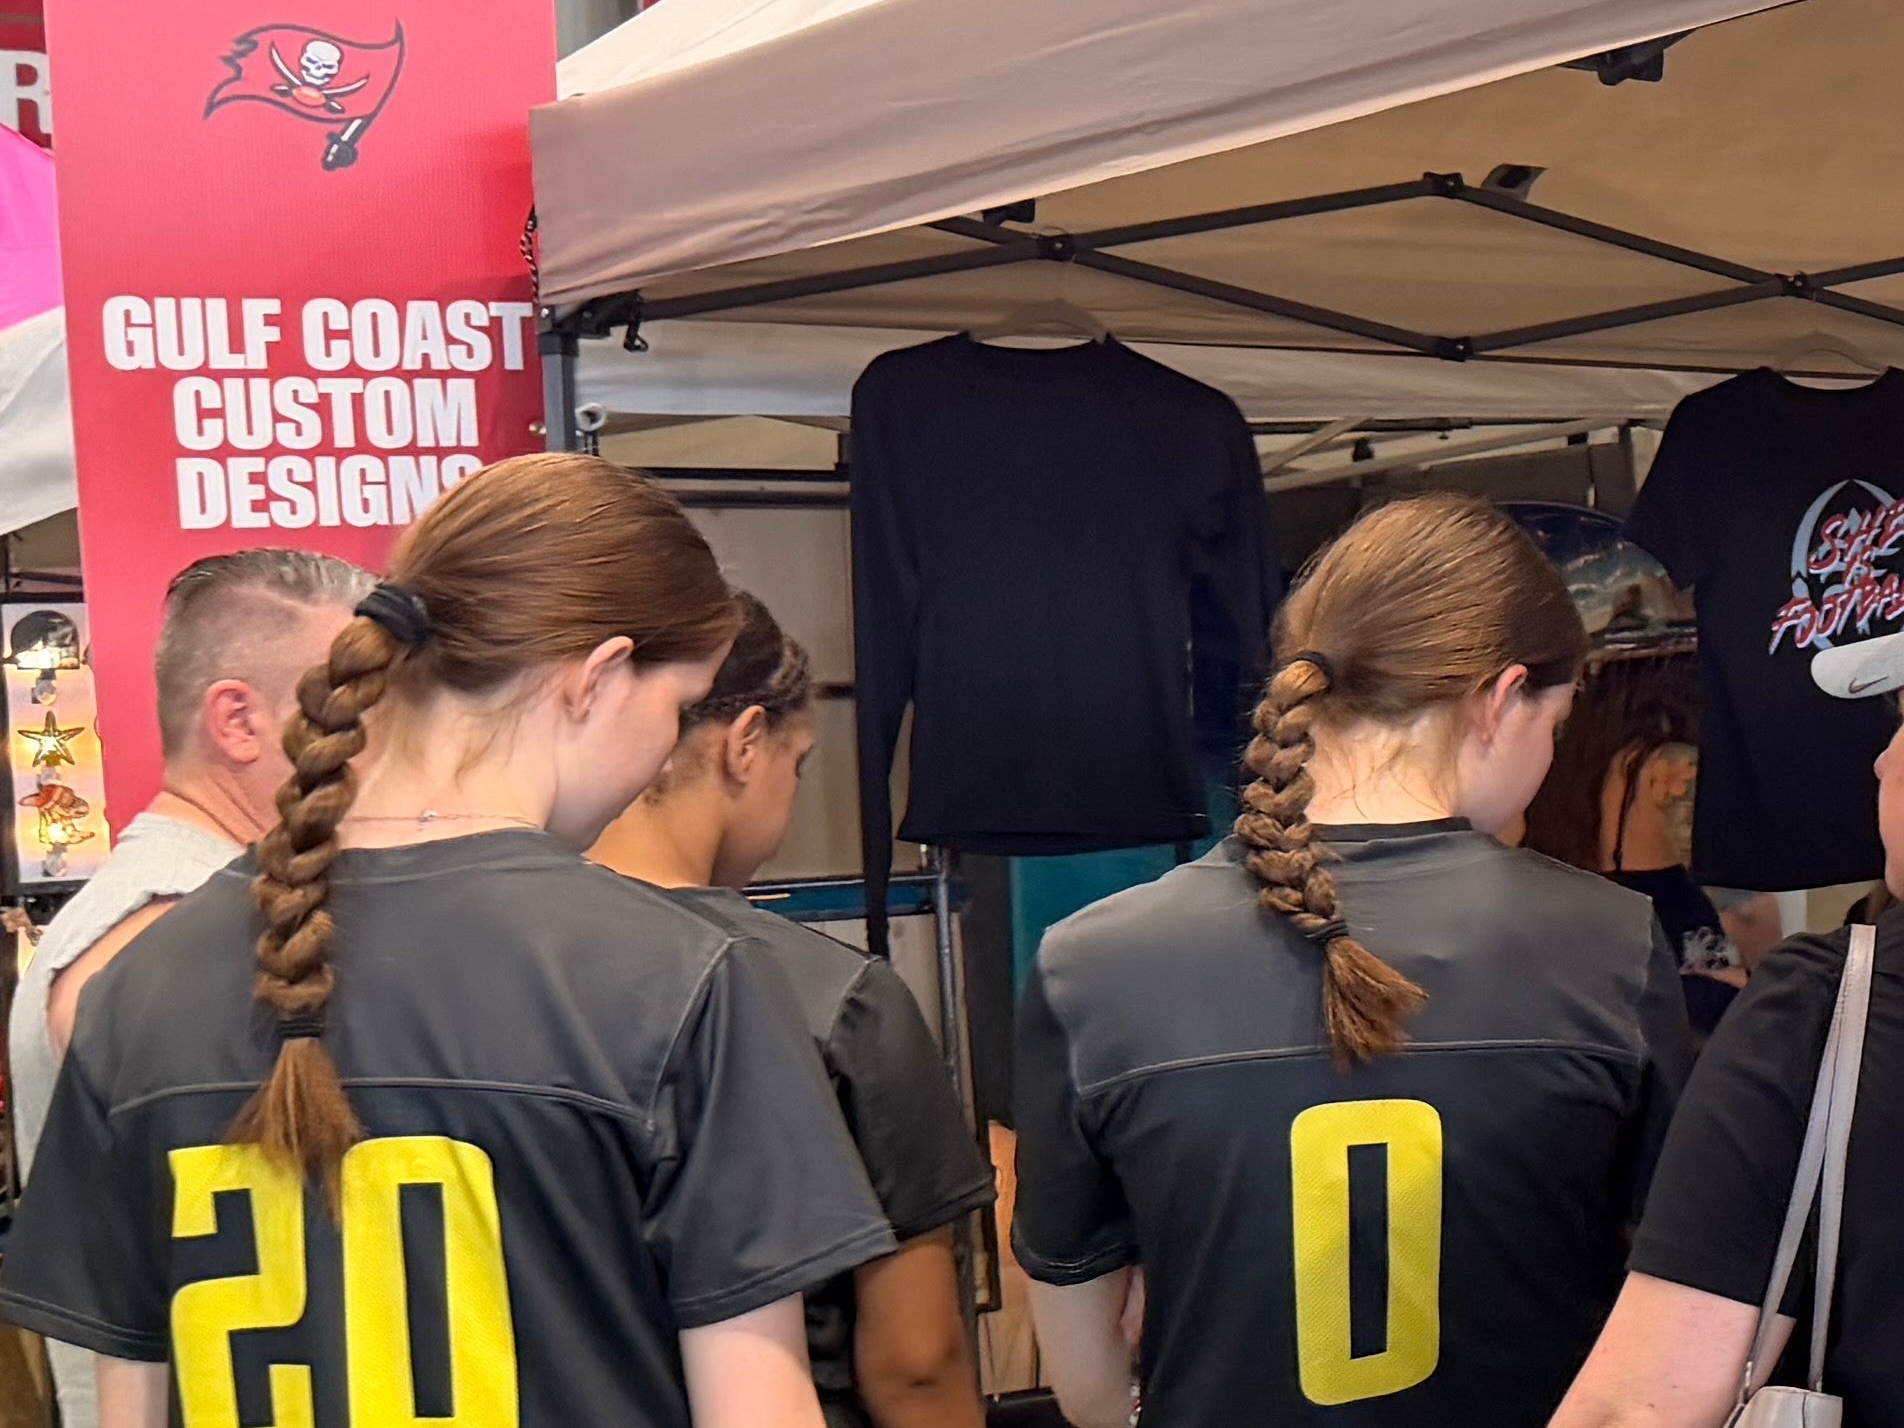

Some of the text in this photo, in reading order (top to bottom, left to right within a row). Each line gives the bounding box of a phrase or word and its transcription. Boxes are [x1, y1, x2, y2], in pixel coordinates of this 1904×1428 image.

[102, 295, 533, 371] GULF COAST
[172, 376, 479, 450] CUSTOM
[1291, 1098, 1443, 1406] 0
